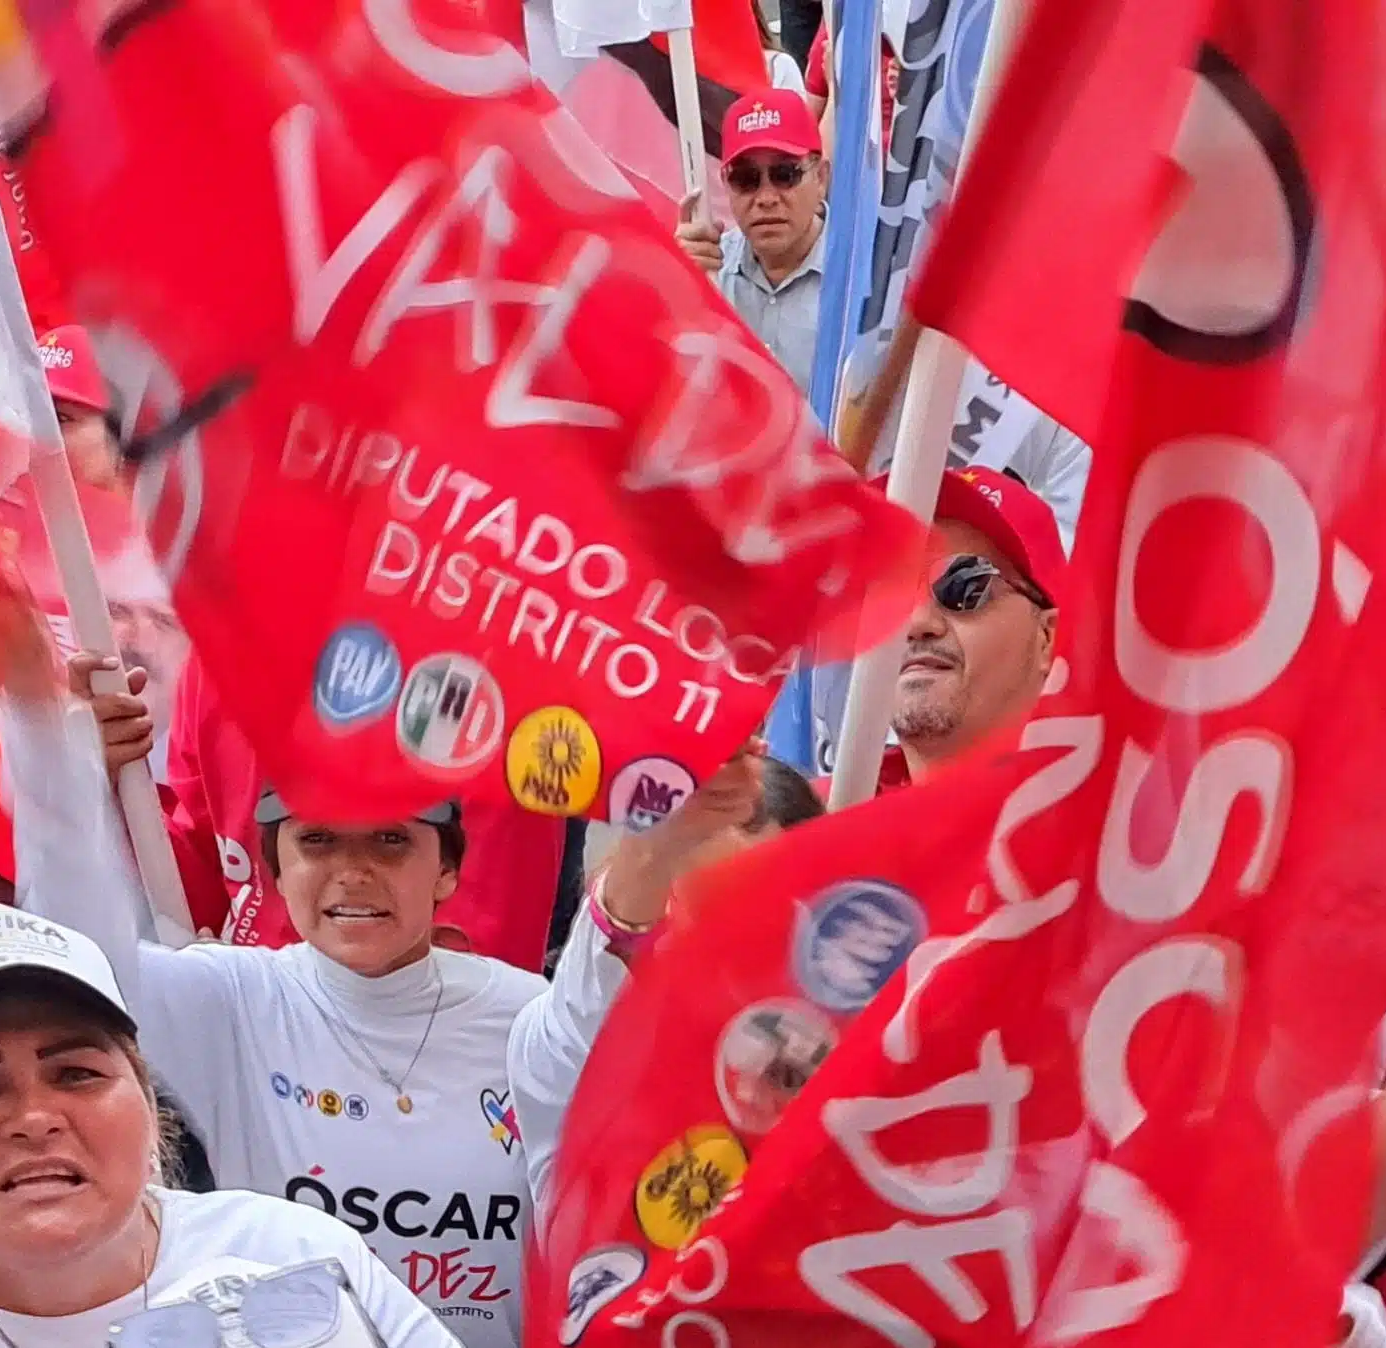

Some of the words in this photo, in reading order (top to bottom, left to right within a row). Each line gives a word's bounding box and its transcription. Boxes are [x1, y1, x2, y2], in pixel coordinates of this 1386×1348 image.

[365, 520, 659, 700] DISTRITO
[671, 680, 721, 735] 11
[285, 1164, 521, 1241] ÓSCAR
